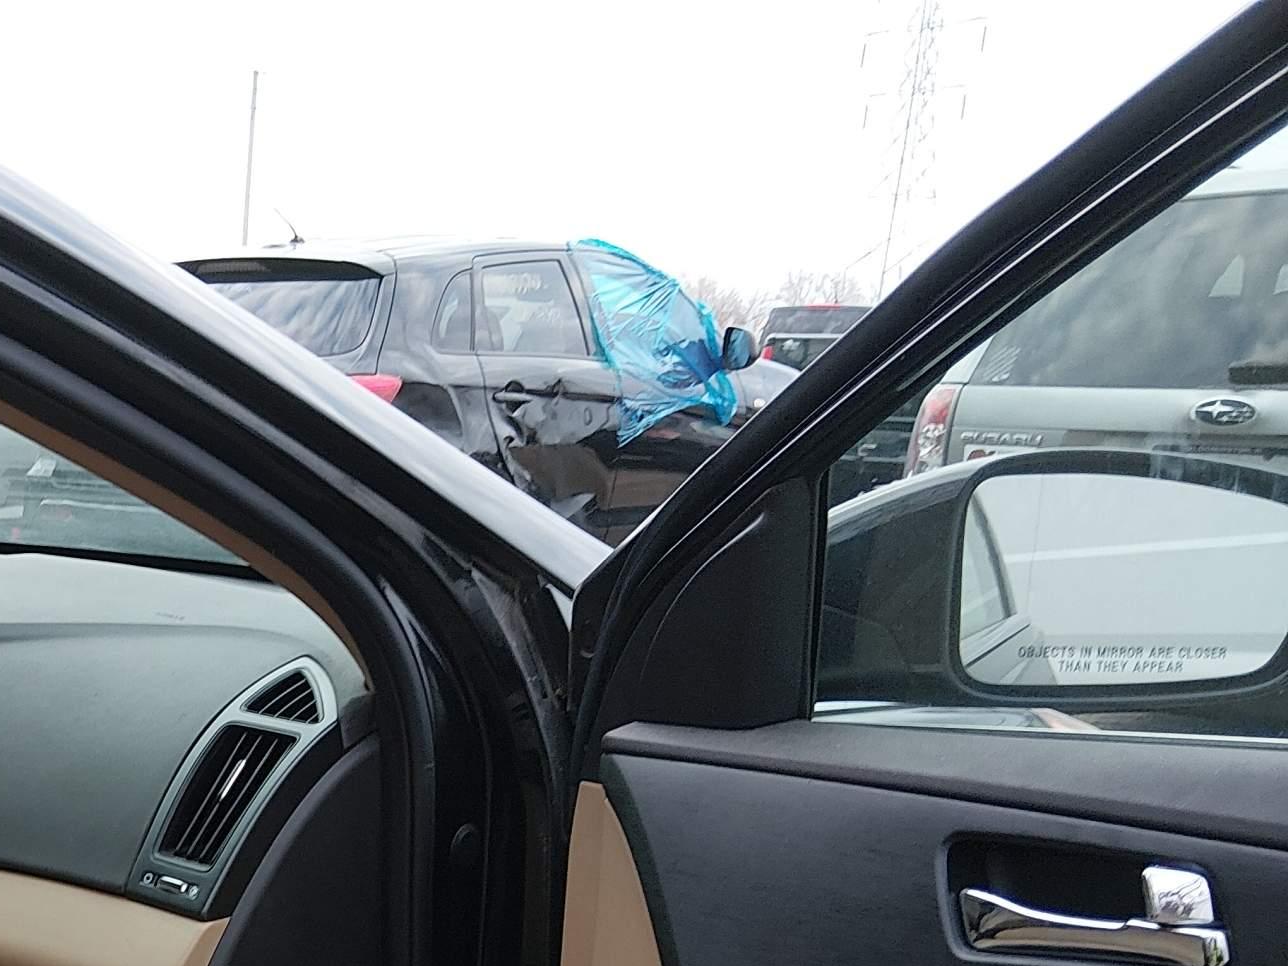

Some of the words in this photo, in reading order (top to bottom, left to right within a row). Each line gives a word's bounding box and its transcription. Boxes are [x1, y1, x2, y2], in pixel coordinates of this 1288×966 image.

[960, 431, 1044, 447] SUBARU
[1017, 646, 1075, 659] OBJECTS
[1079, 646, 1092, 659] IN
[1096, 646, 1144, 659] MIRROR
[1148, 646, 1176, 659] ARE
[1176, 646, 1228, 660] CLOSER
[1057, 660, 1091, 673] THAN
[1095, 660, 1128, 673] THEY
[1132, 660, 1184, 673] APPEAR
